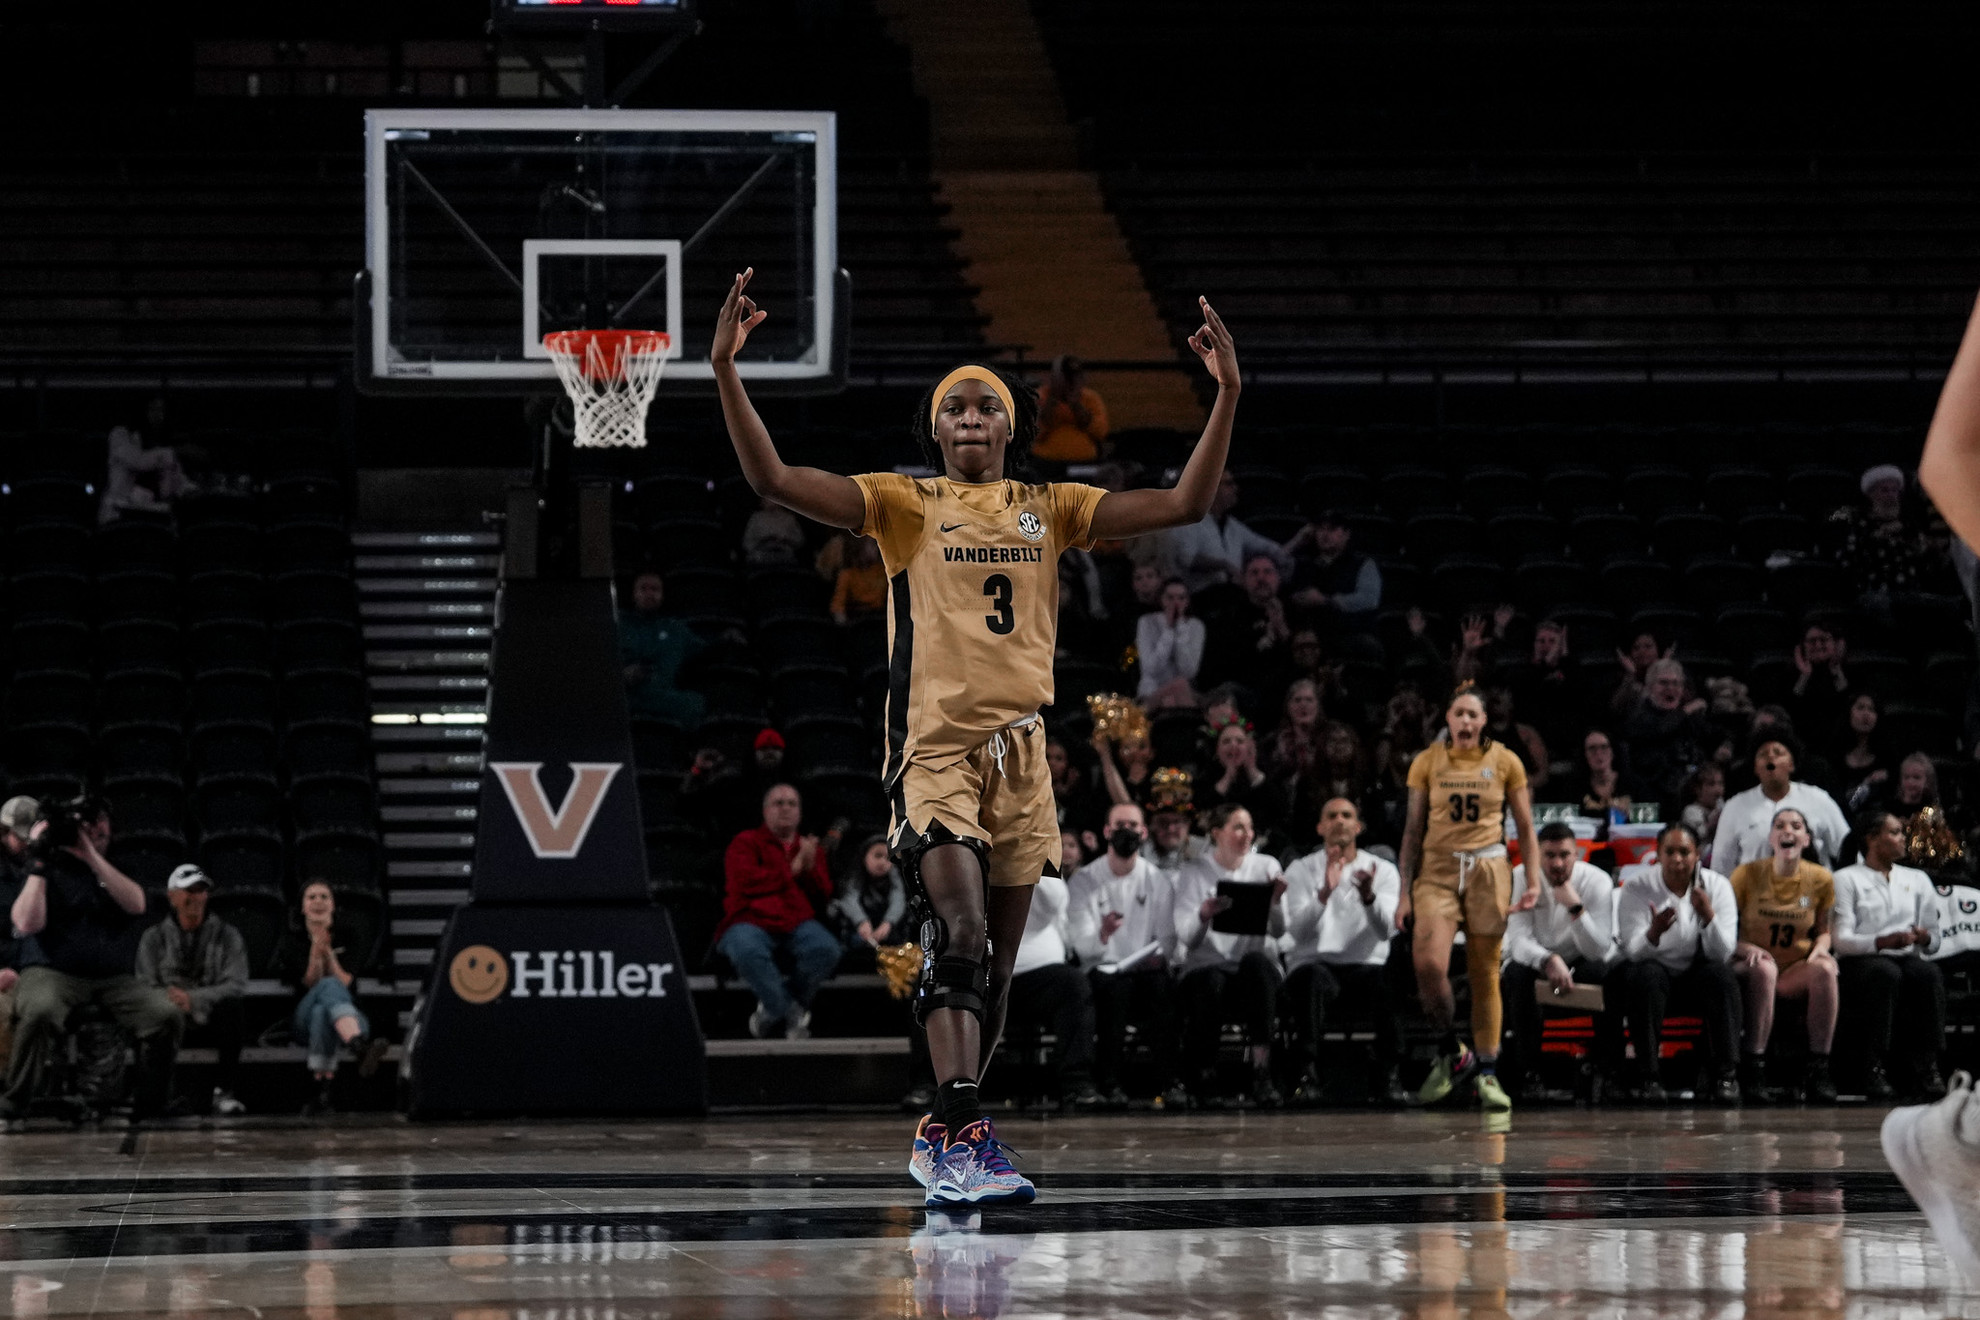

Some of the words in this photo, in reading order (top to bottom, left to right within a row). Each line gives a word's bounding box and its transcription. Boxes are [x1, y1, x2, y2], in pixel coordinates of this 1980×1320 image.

[1019, 511, 1040, 534] SEC
[944, 547, 1042, 562] VANDERBILT
[983, 573, 1015, 635] 3
[489, 761, 624, 859] V
[1449, 793, 1479, 822] 35
[1769, 924, 1795, 947] 13
[510, 950, 674, 998] Hiller
